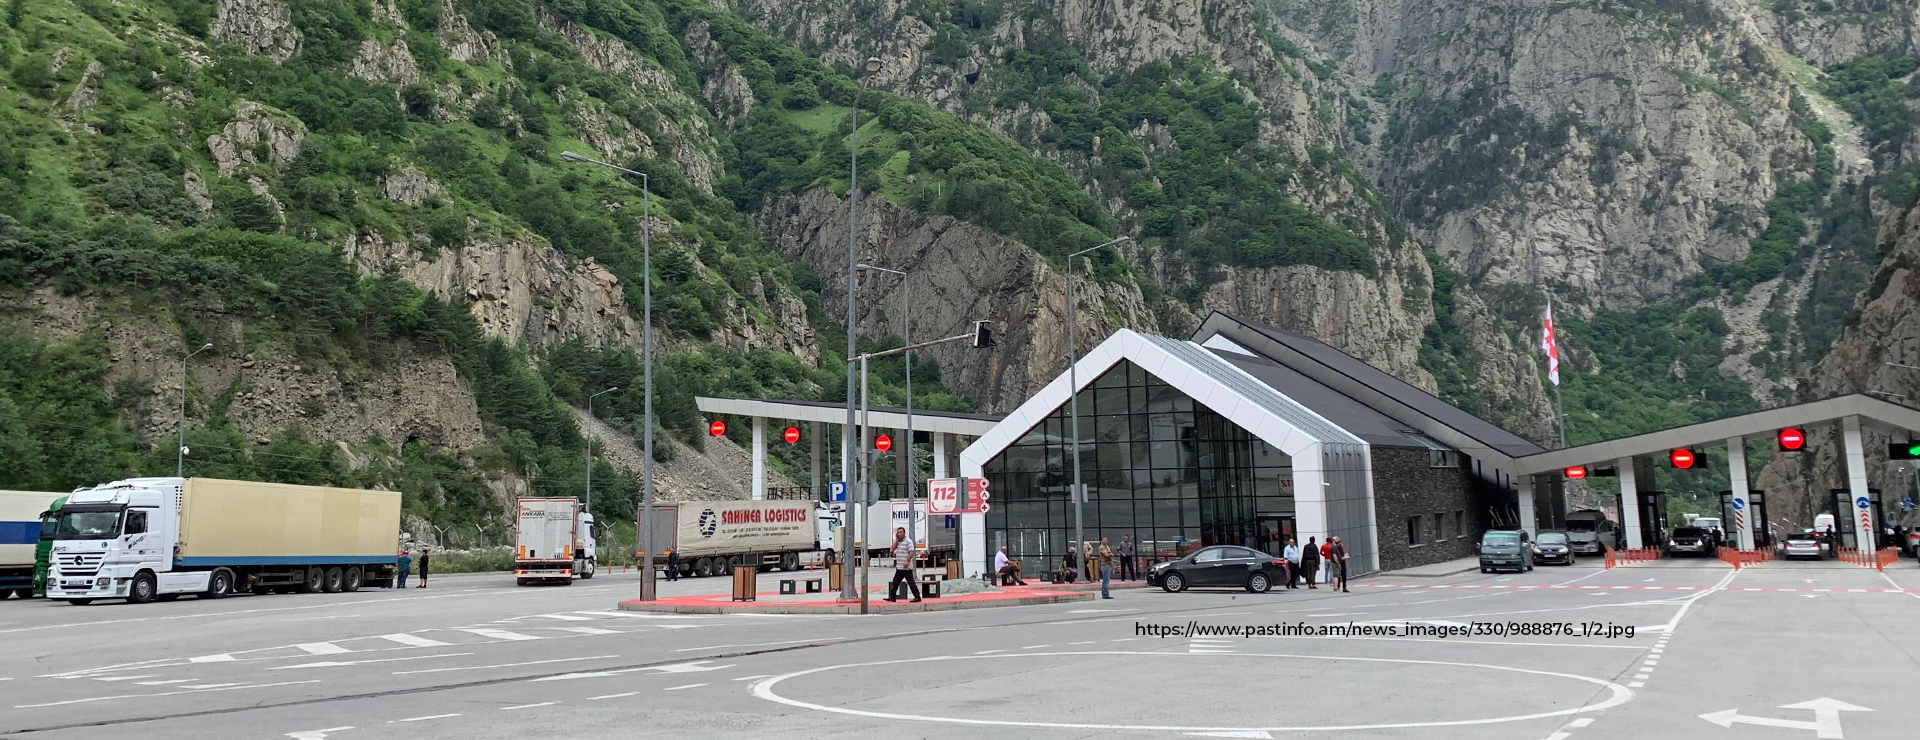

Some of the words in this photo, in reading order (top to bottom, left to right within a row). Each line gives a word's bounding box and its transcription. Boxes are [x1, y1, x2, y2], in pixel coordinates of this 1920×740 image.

[832, 483, 844, 501] P
[934, 487, 956, 500] 112
[764, 508, 806, 522] LOGISTICS
